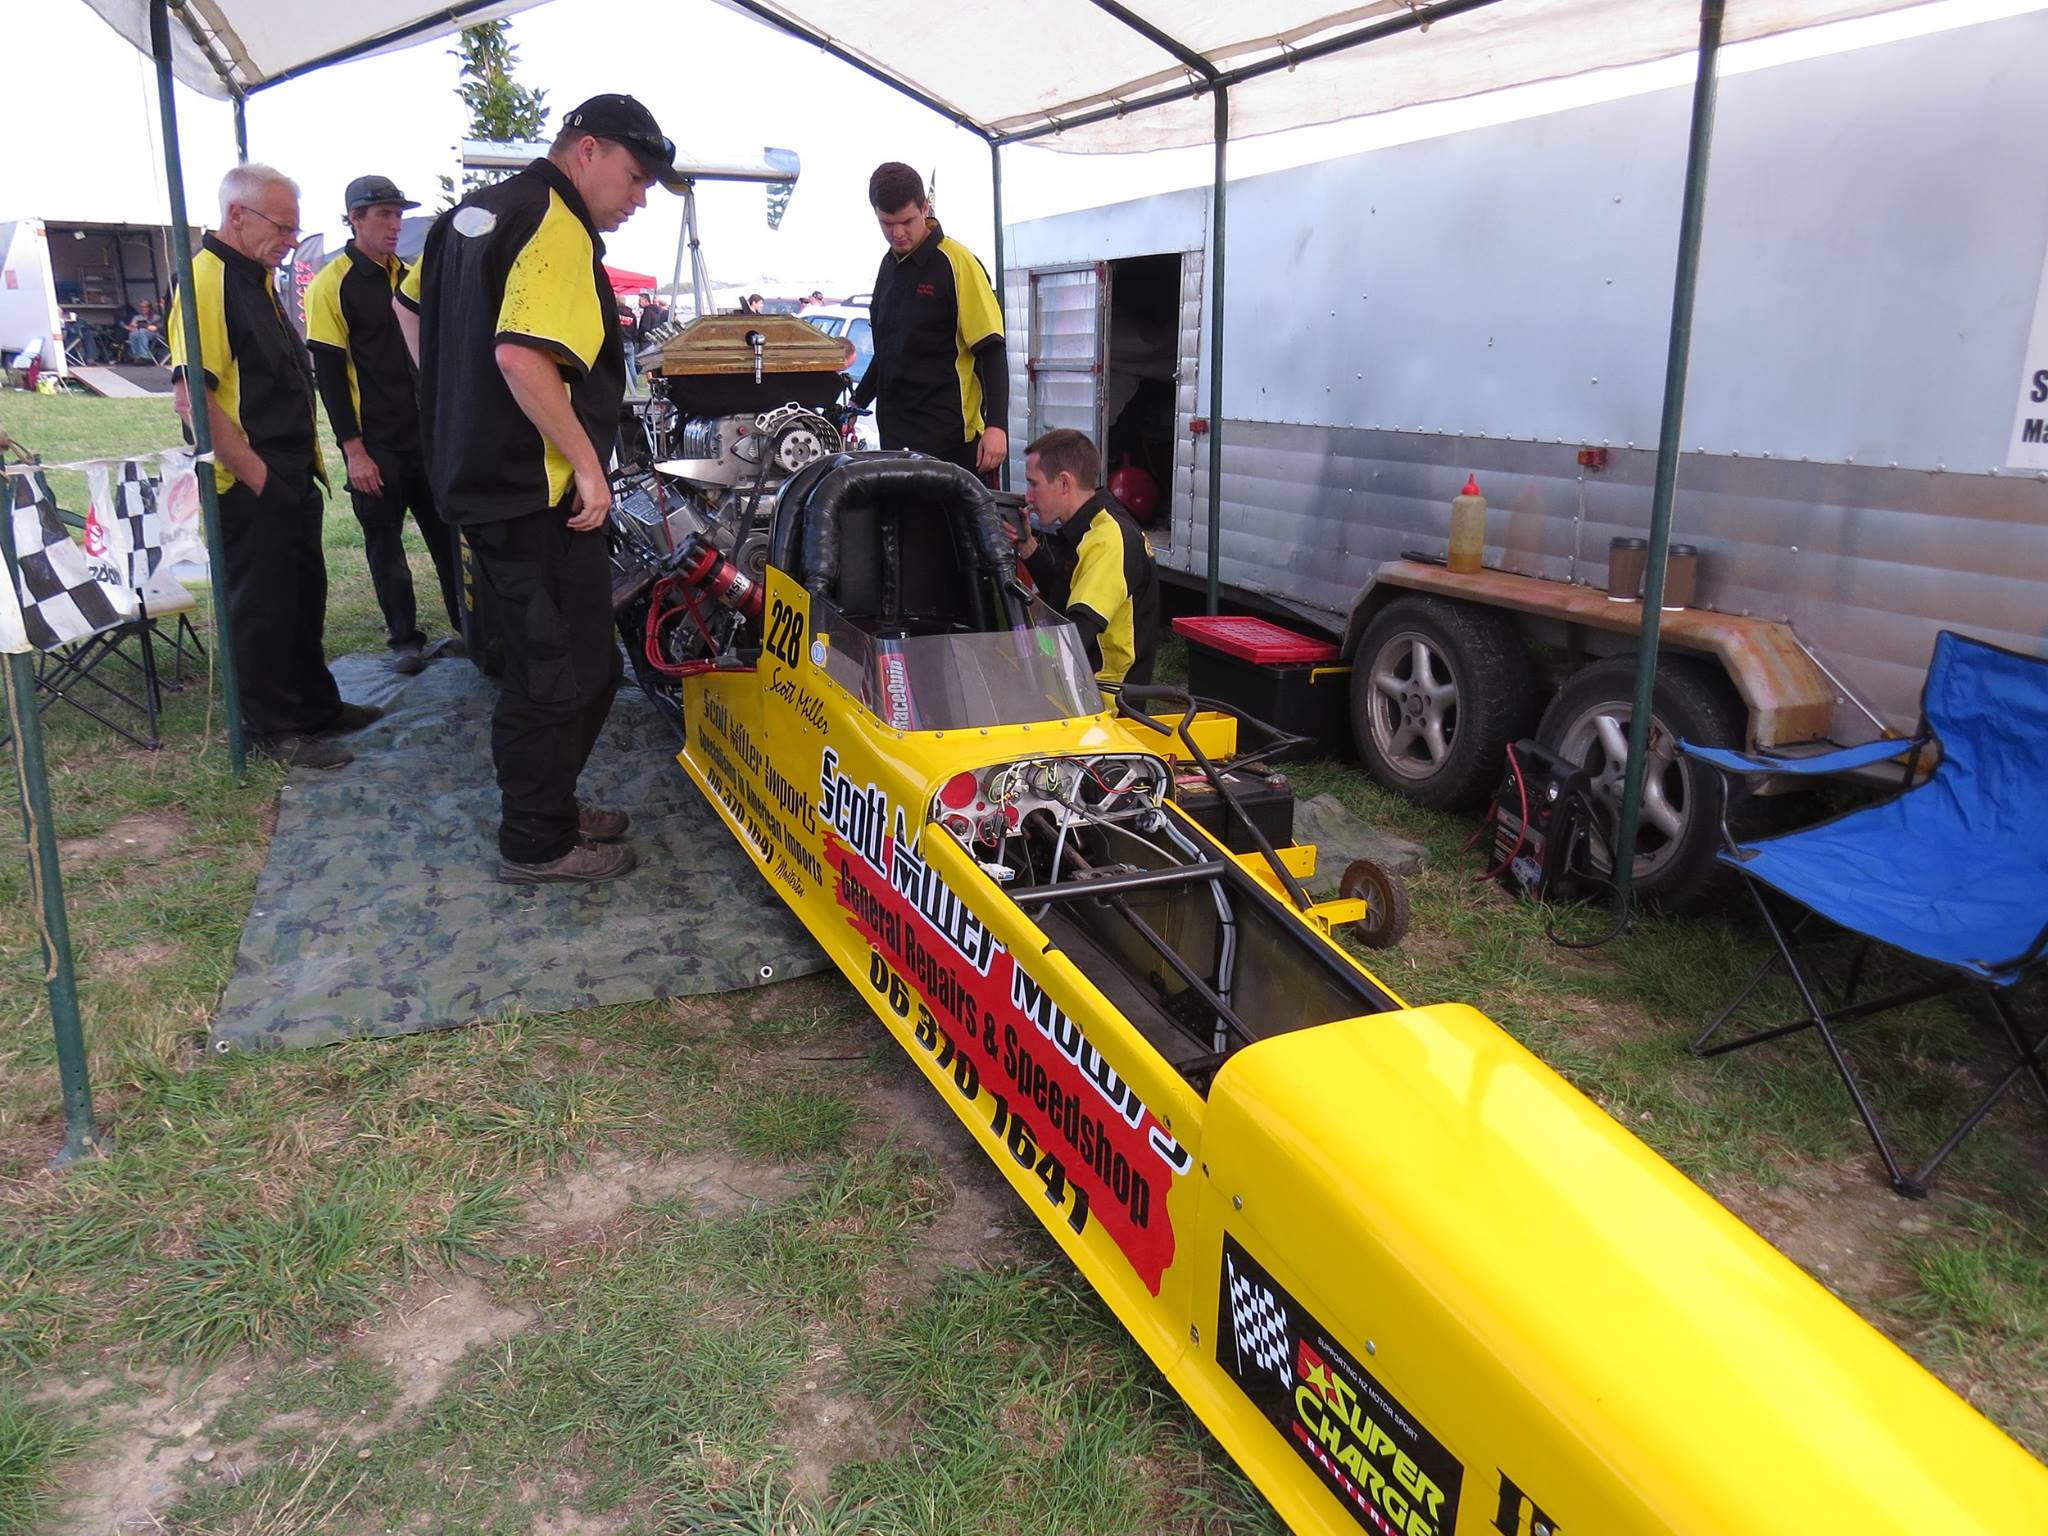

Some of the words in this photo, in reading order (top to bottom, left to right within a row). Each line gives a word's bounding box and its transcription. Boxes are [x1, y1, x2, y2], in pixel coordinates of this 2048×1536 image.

[726, 572, 744, 600] MSD
[766, 600, 803, 669] 228
[769, 666, 797, 705] Scott
[795, 687, 829, 735] Miller
[886, 659, 910, 731] RaceQuip
[704, 688, 728, 740] Scott
[730, 713, 762, 777] Miller
[765, 754, 816, 836] Imports
[723, 787, 746, 824] 370
[818, 746, 888, 880] Scott
[746, 780, 783, 843] American
[784, 823, 823, 887] Imports
[840, 858, 901, 951] General
[905, 922, 977, 1038] Repairs
[983, 1011, 999, 1063] &
[1004, 1024, 1150, 1229] Speedshop
[869, 951, 910, 1018] 06
[914, 1003, 979, 1100] 370
[990, 1090, 1090, 1236] 1641
[1317, 1336, 1358, 1382] SUPPORTING
[1358, 1377, 1369, 1392] NZ
[1368, 1387, 1394, 1419] MOTOR
[1394, 1414, 1420, 1441] SPORT
[1307, 1437, 1397, 1536] BATTERI
[1327, 1372, 1445, 1522] SUPER
